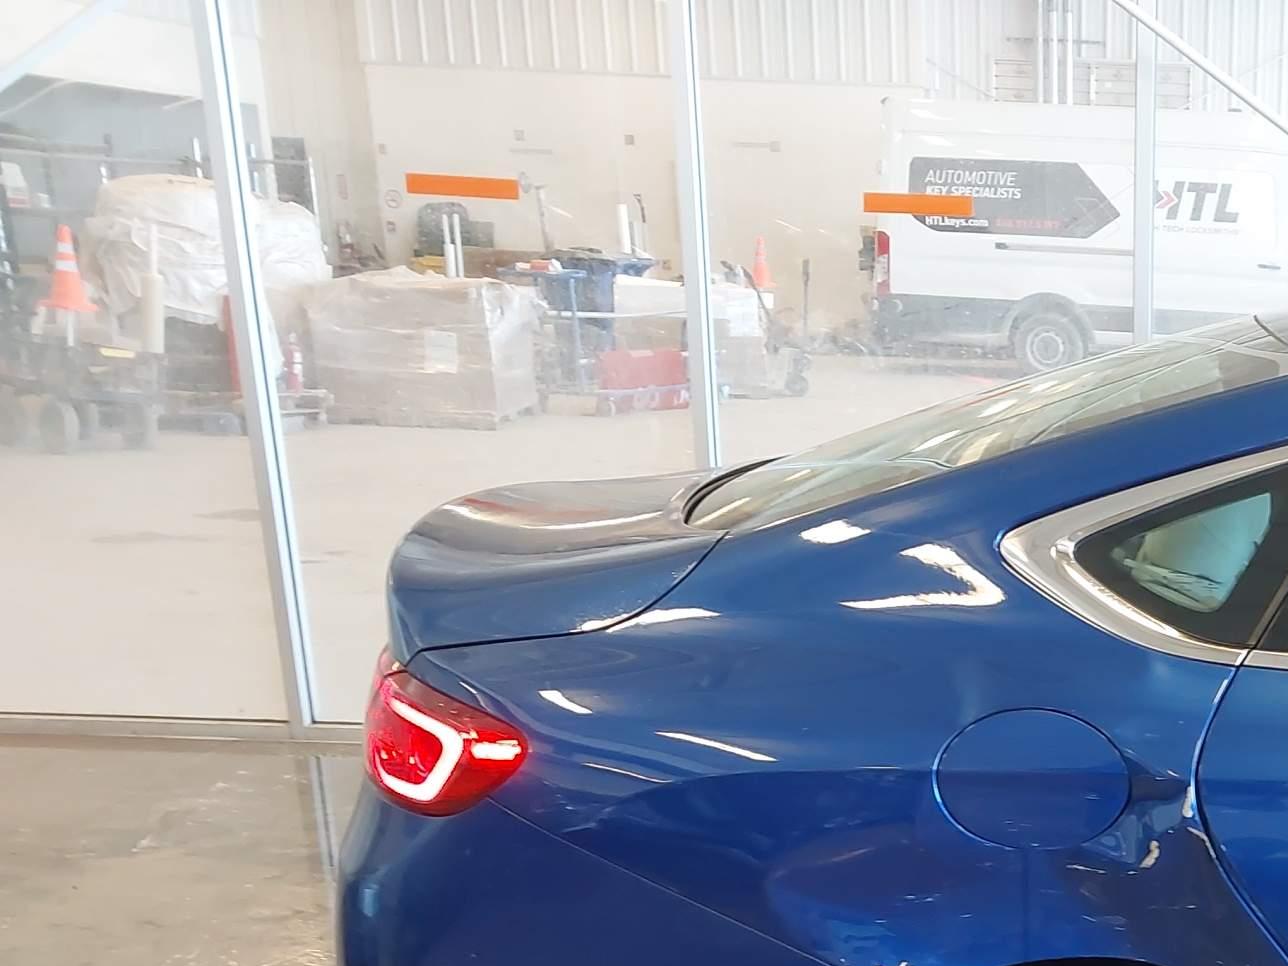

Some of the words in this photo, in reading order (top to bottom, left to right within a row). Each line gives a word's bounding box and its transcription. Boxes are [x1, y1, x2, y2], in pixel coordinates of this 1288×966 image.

[925, 169, 1018, 186] AUTOMOTIVE
[926, 185, 948, 195] KEY
[951, 186, 1022, 199] SPECIALISTS
